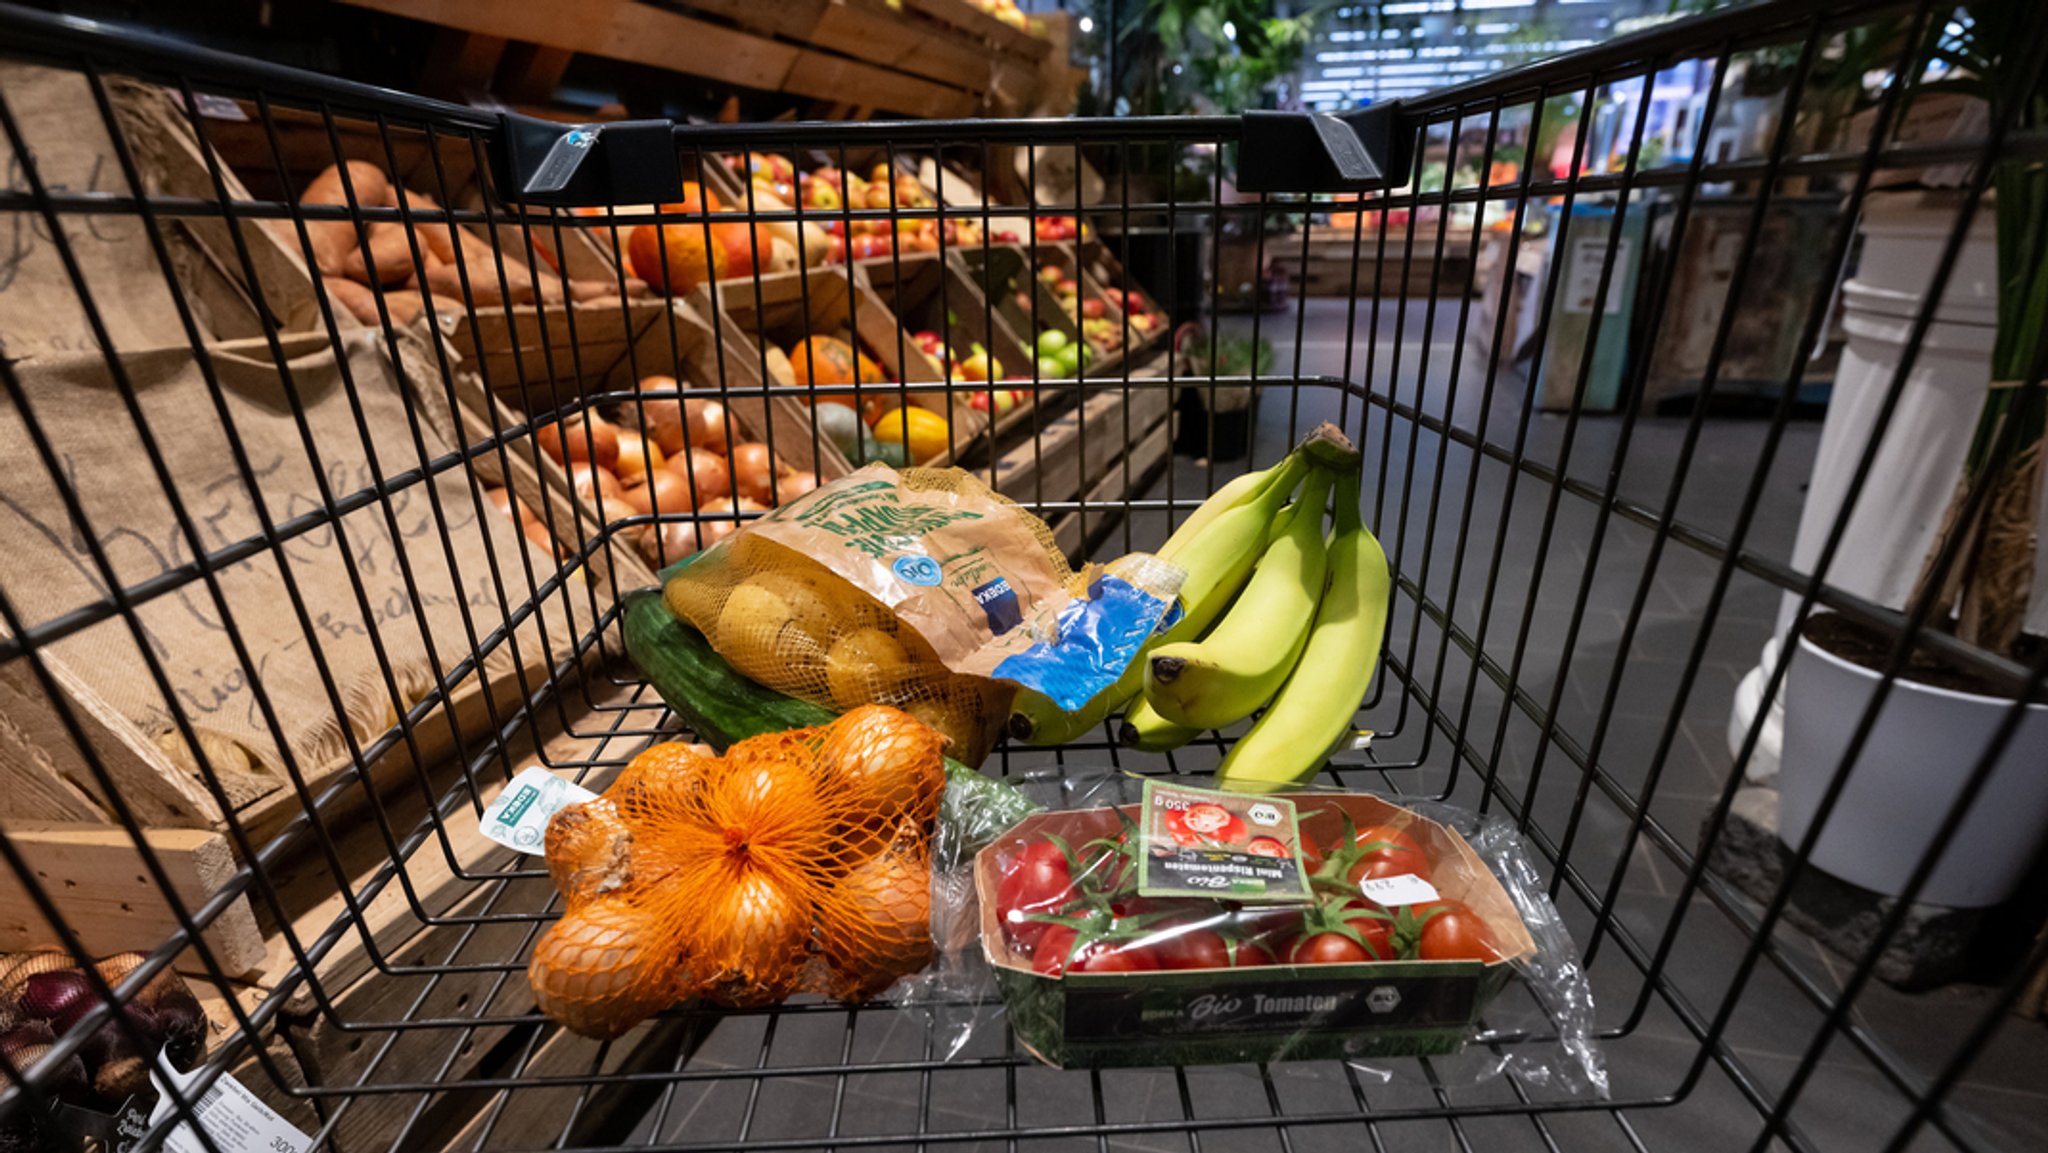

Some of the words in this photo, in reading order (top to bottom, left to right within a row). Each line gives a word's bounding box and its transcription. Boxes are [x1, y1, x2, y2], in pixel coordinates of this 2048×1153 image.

[975, 580, 1012, 604] EDEKA
[1155, 796, 1164, 807] g
[1166, 800, 1190, 811] 350
[1164, 861, 1251, 875] Rispentomaten
[1256, 867, 1283, 879] Mini
[1187, 876, 1231, 888] Bio
[1187, 994, 1243, 1020] Bio
[1254, 993, 1337, 1015] Tomaten
[269, 1136, 302, 1153] 300
